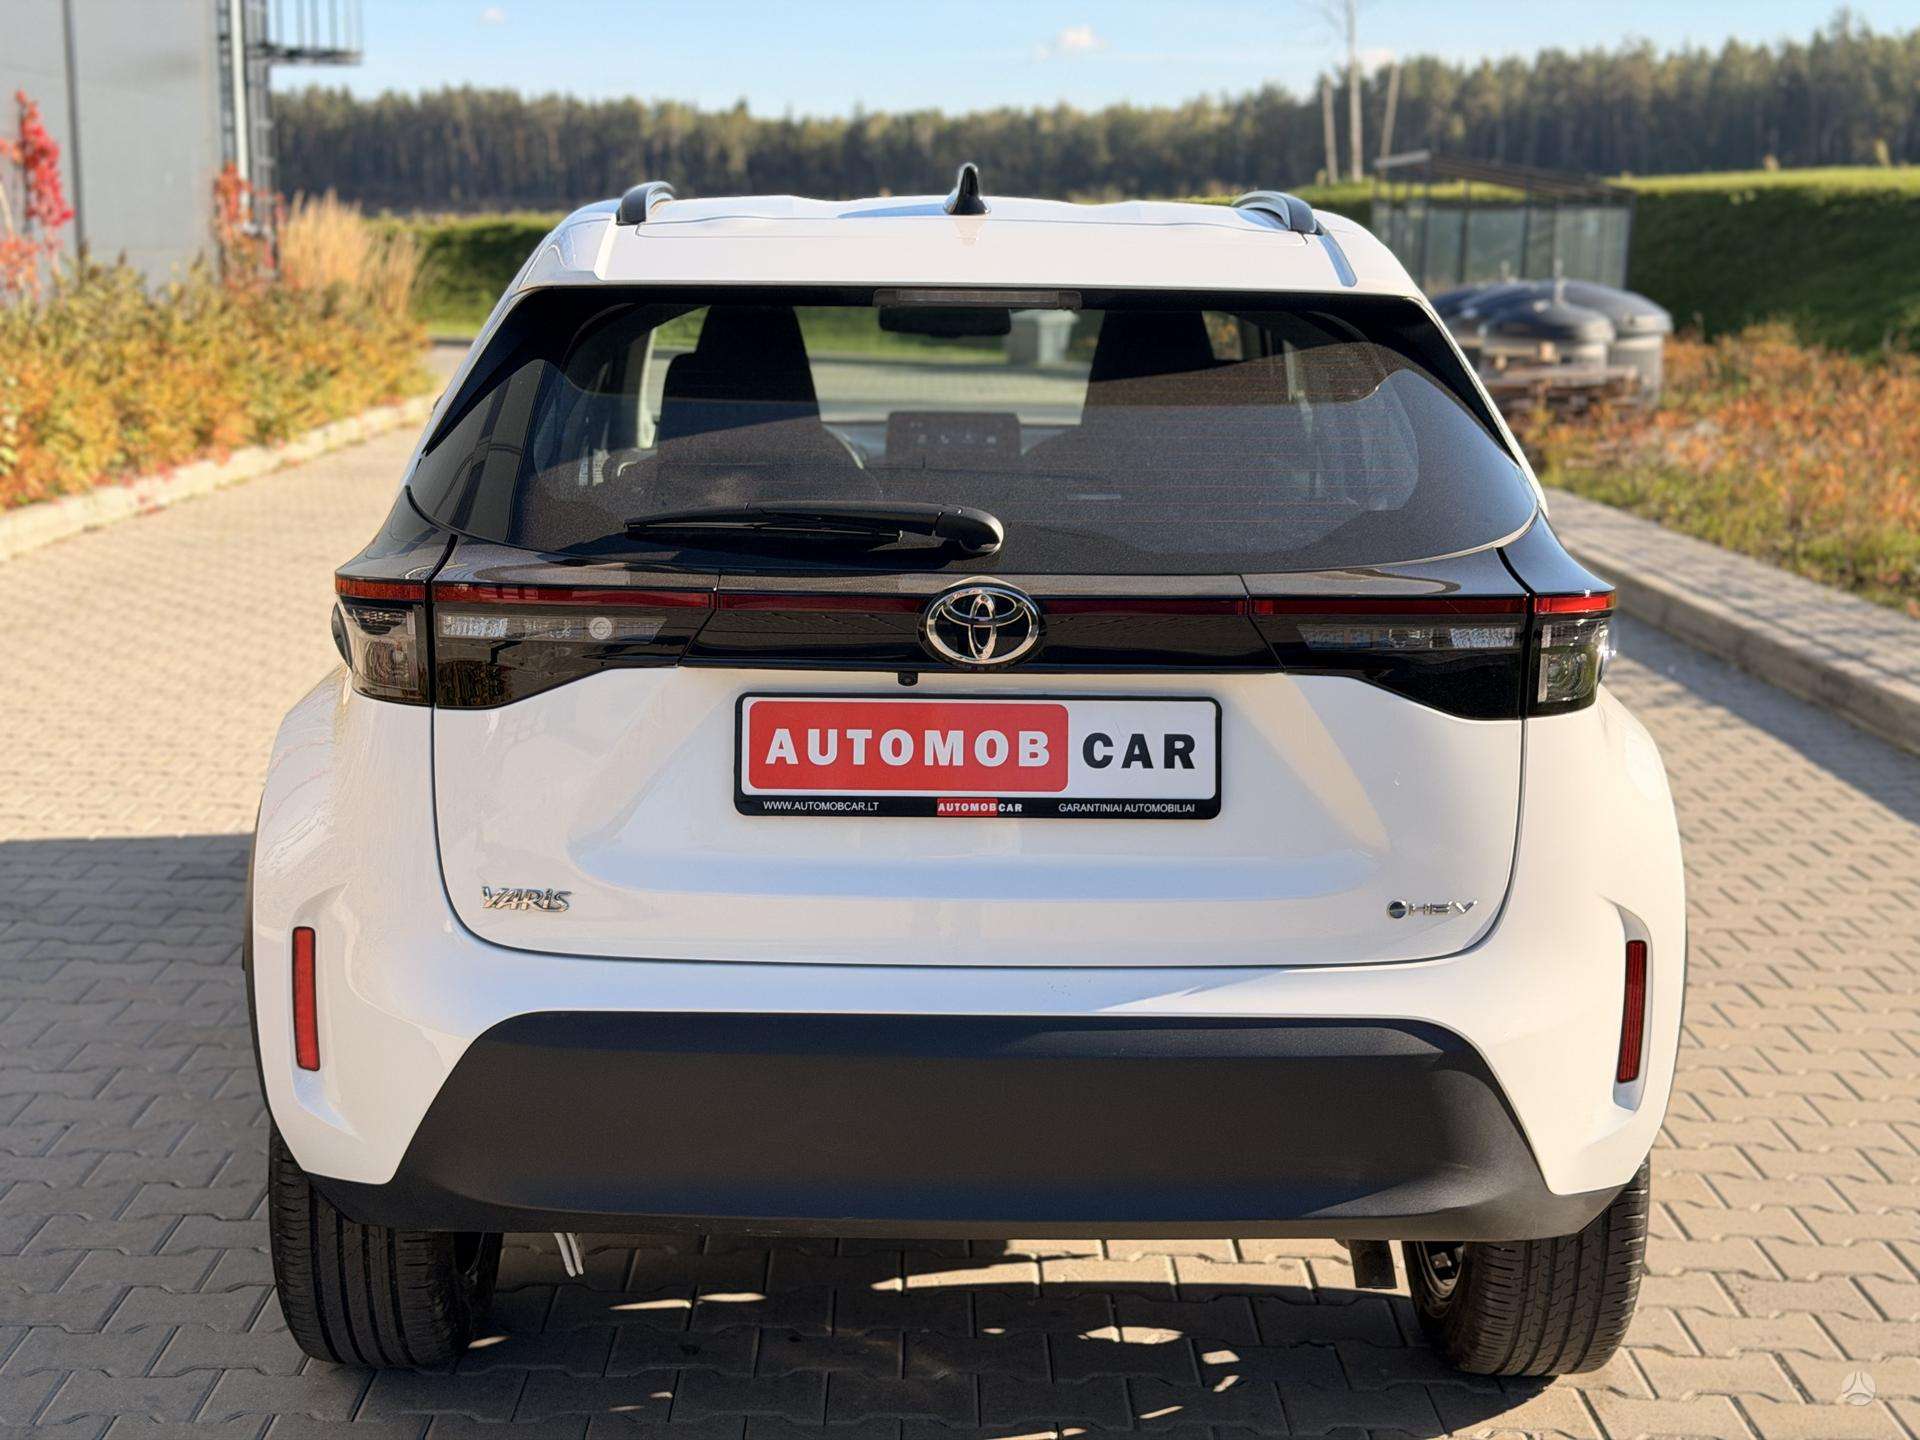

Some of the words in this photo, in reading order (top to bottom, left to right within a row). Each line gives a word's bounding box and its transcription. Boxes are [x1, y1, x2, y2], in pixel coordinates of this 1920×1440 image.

[765, 728, 1051, 768] AUTOMOB
[1081, 732, 1197, 770] CAR
[763, 801, 880, 812] WWW.AUTOMOBCAR.LT
[1058, 803, 1123, 813] GARANTINIAI
[1124, 803, 1195, 814] AUTOMOBILIAI
